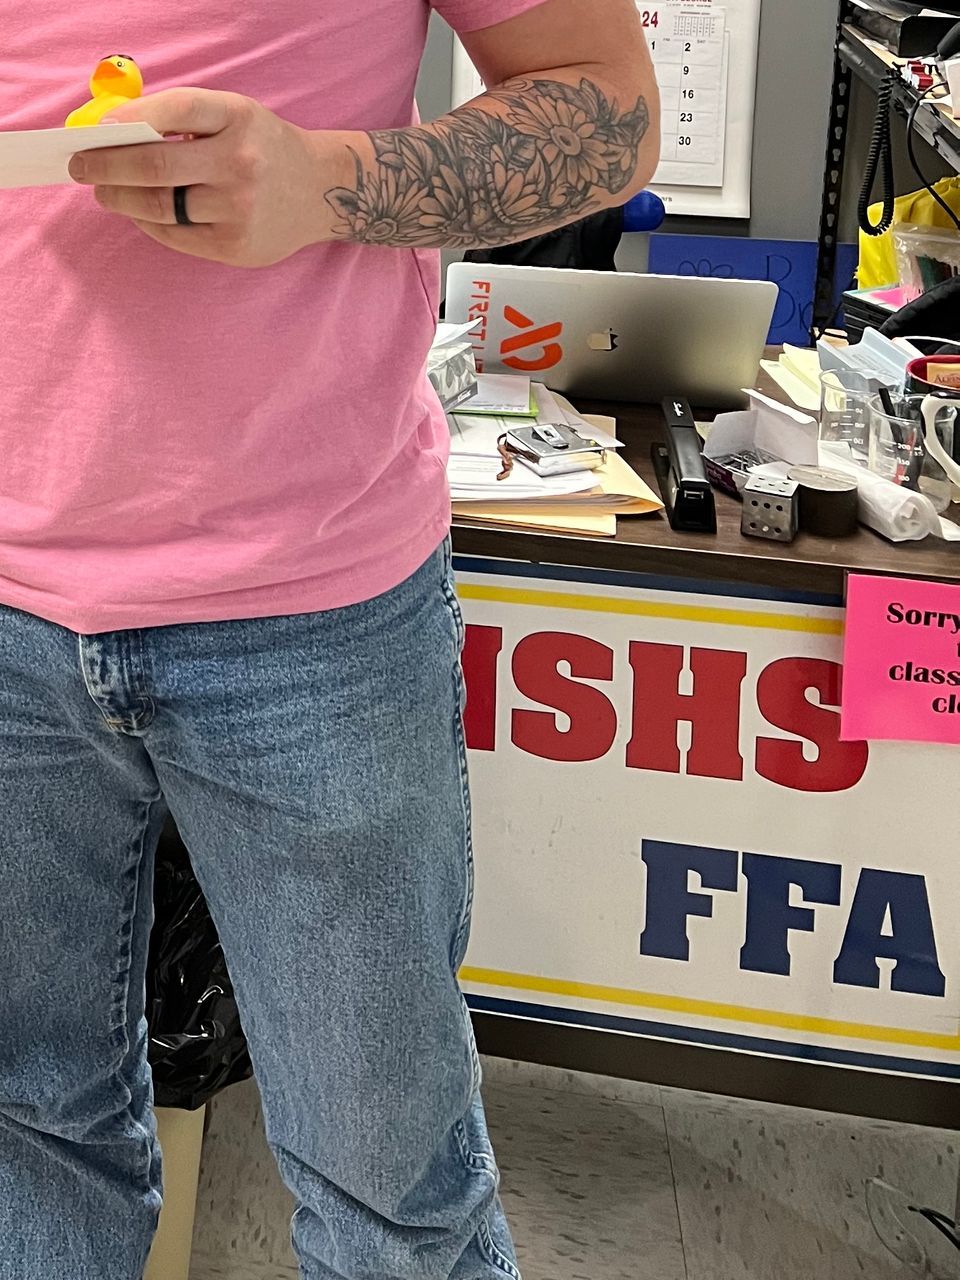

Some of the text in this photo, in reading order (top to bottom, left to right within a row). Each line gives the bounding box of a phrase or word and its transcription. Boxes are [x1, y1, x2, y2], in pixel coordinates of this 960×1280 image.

[642, 11, 658, 28] 24
[651, 41, 691, 52] 1 2
[683, 66, 689, 75] 9
[682, 89, 694, 99] 16
[680, 113, 693, 123] 23
[678, 136, 691, 146] 30
[468, 281, 490, 340] FIRST
[887, 602, 960, 634] Sorry
[889, 662, 960, 686] class
[932, 694, 960, 714] cl
[640, 838, 946, 997] FFA
